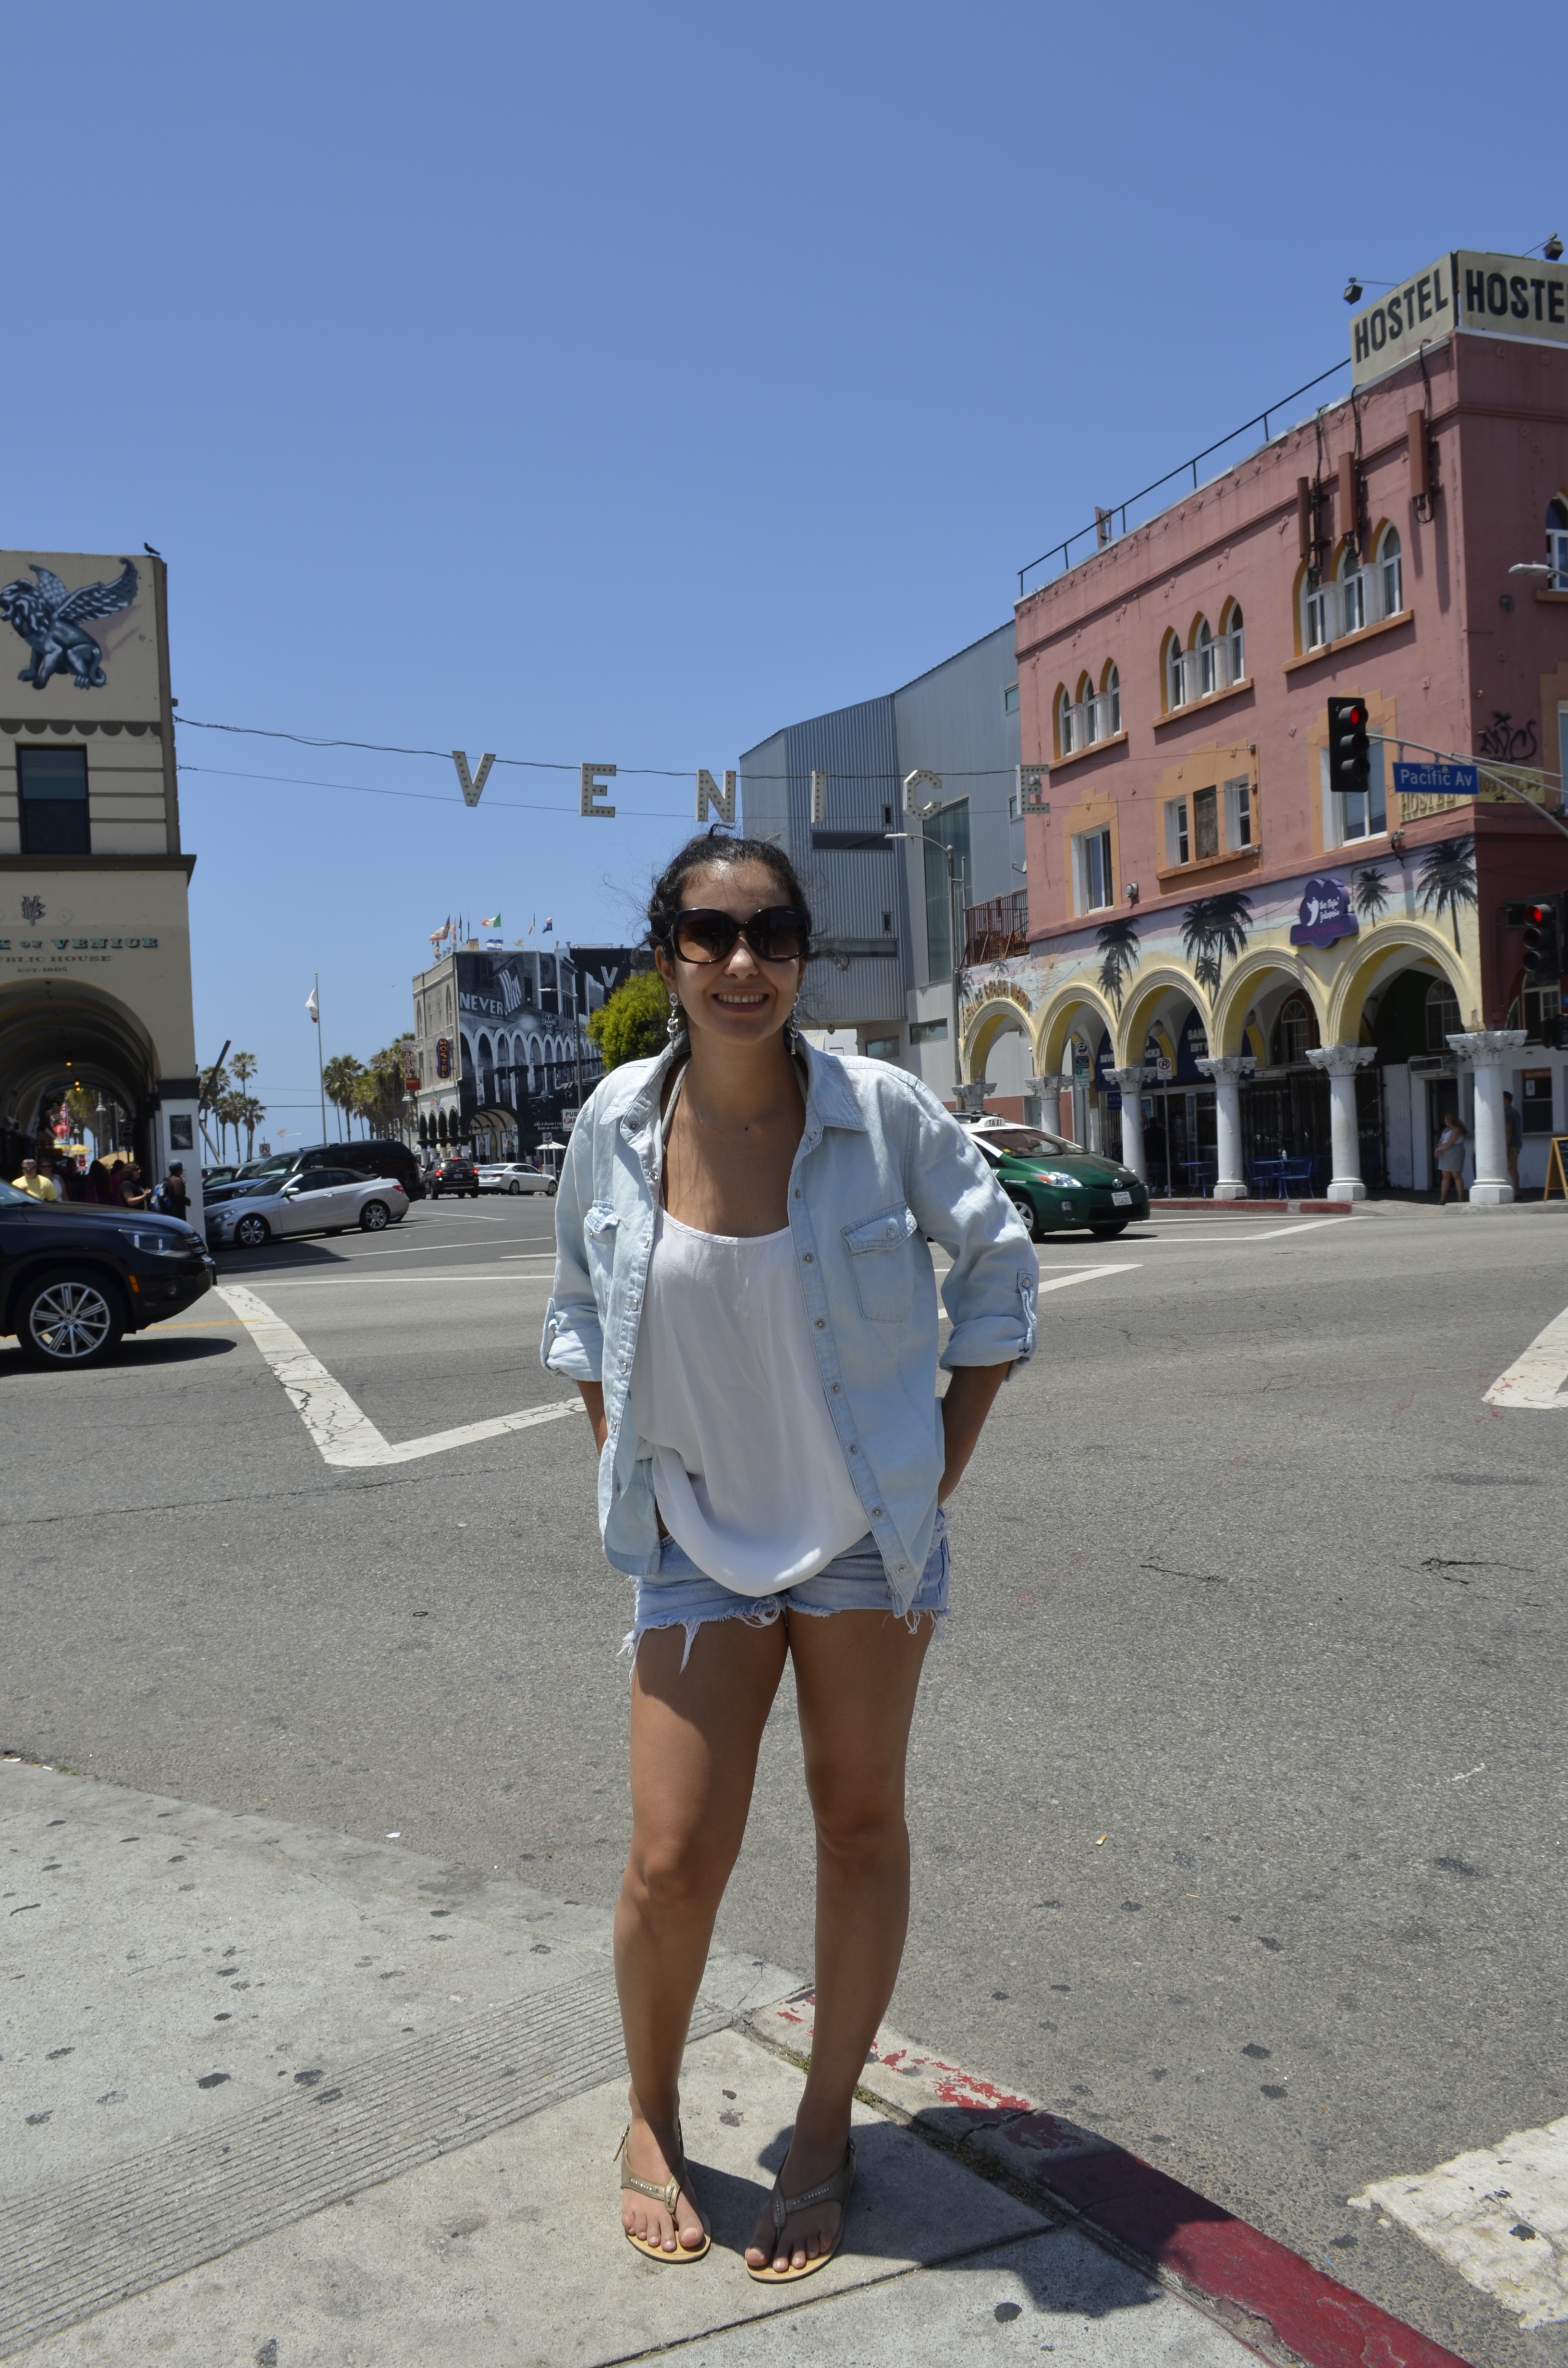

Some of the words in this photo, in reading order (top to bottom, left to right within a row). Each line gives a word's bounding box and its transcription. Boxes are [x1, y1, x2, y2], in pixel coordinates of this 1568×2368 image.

[1466, 269, 1568, 324] HOSTE
[1355, 268, 1448, 364] HOSTEL
[453, 750, 1051, 822] VENICE
[1400, 769, 1451, 785] Pacific
[1455, 771, 1472, 786] Av
[50, 938, 158, 950] VENICE
[460, 991, 503, 1016] NEVER
[438, 1040, 447, 1077] HOSTEL
[1190, 1043, 1204, 1053] EBT
